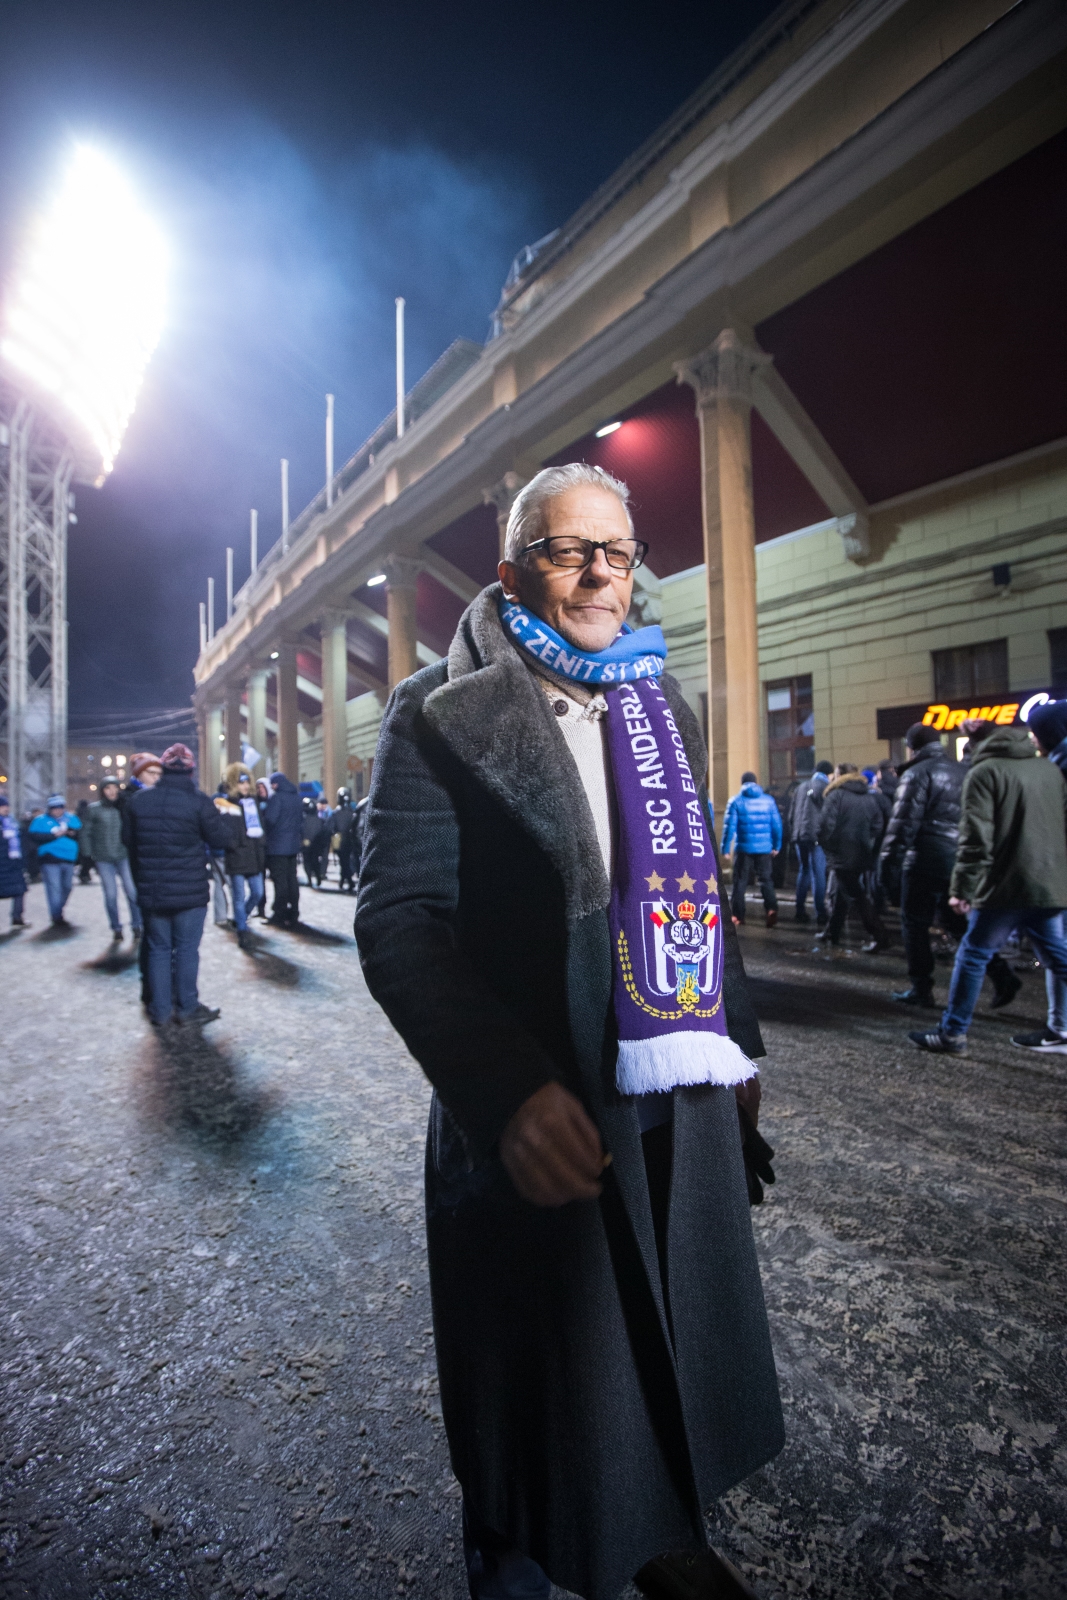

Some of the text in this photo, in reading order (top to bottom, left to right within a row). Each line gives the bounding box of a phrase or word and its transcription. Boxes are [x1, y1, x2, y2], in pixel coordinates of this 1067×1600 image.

[502, 604, 530, 635] FC
[525, 629, 602, 680] ZENIT
[600, 662, 631, 683] ST
[921, 703, 1020, 731] DRIVE
[662, 708, 697, 794] EUROPA
[645, 798, 678, 855] RSC
[685, 799, 705, 858] UEFA
